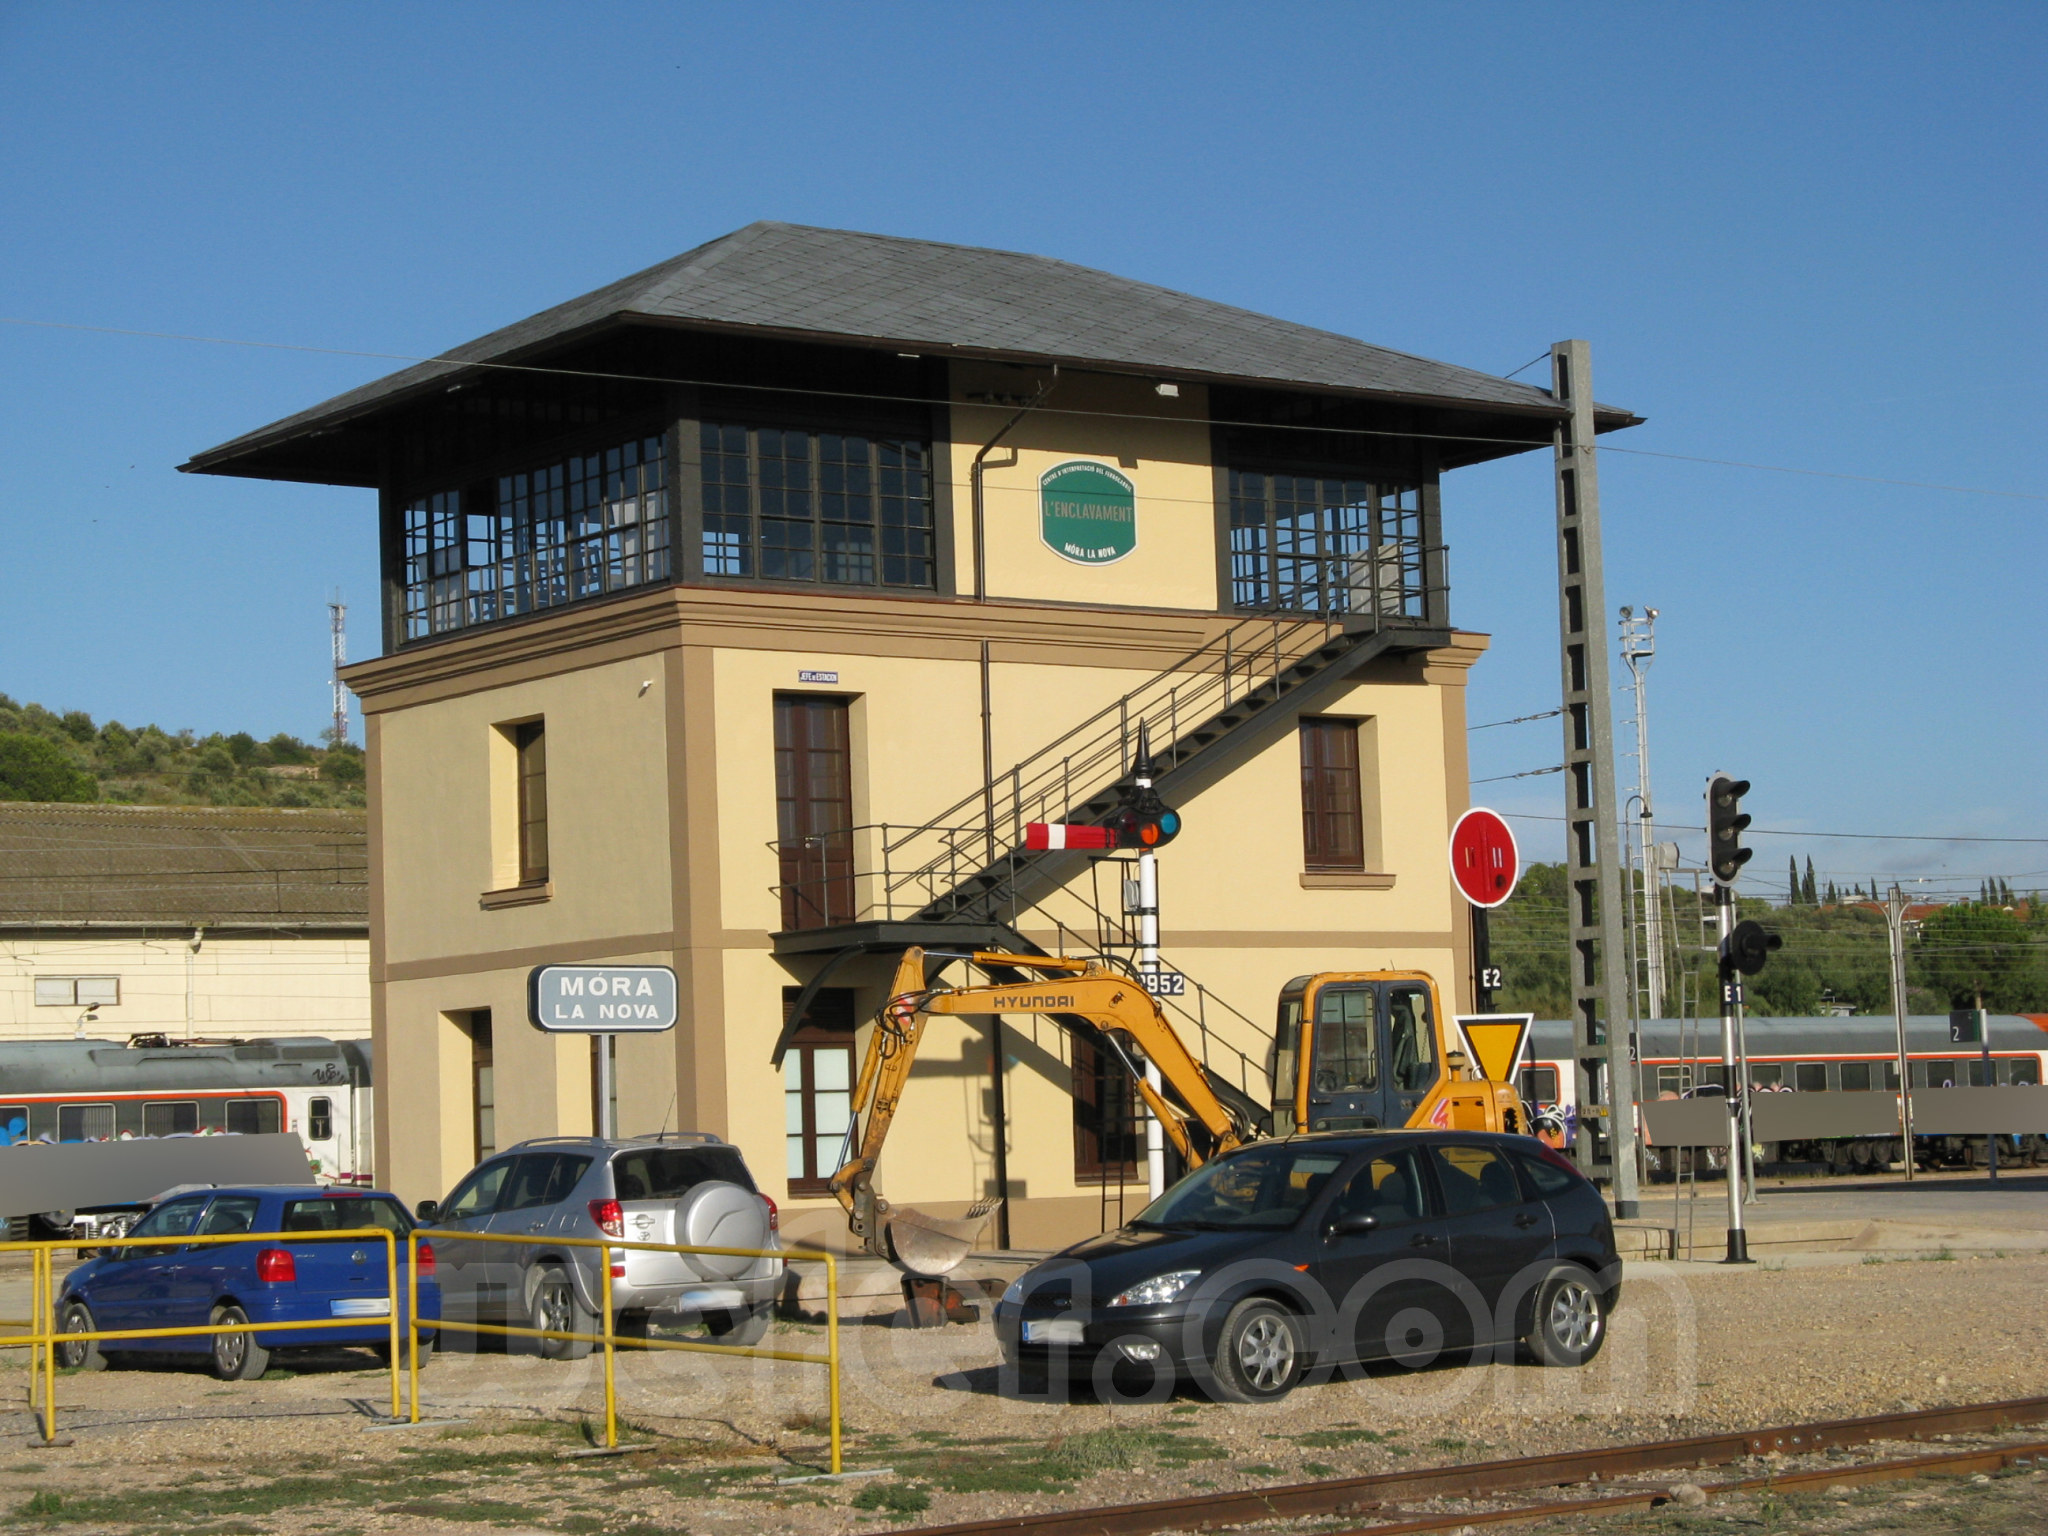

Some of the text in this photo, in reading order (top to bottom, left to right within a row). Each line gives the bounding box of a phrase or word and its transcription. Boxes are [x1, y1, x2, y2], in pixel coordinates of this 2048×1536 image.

[1095, 466, 1104, 475] DEL
[1044, 500, 1133, 523] L'ENCLAVAMENT
[1064, 542, 1117, 559] MÓRA LA NOVA
[559, 971, 654, 997] MÓRA
[993, 995, 1075, 1008] HYUNDAI
[554, 1003, 660, 1020] LA NOVA
[1952, 1026, 1960, 1042] 2
